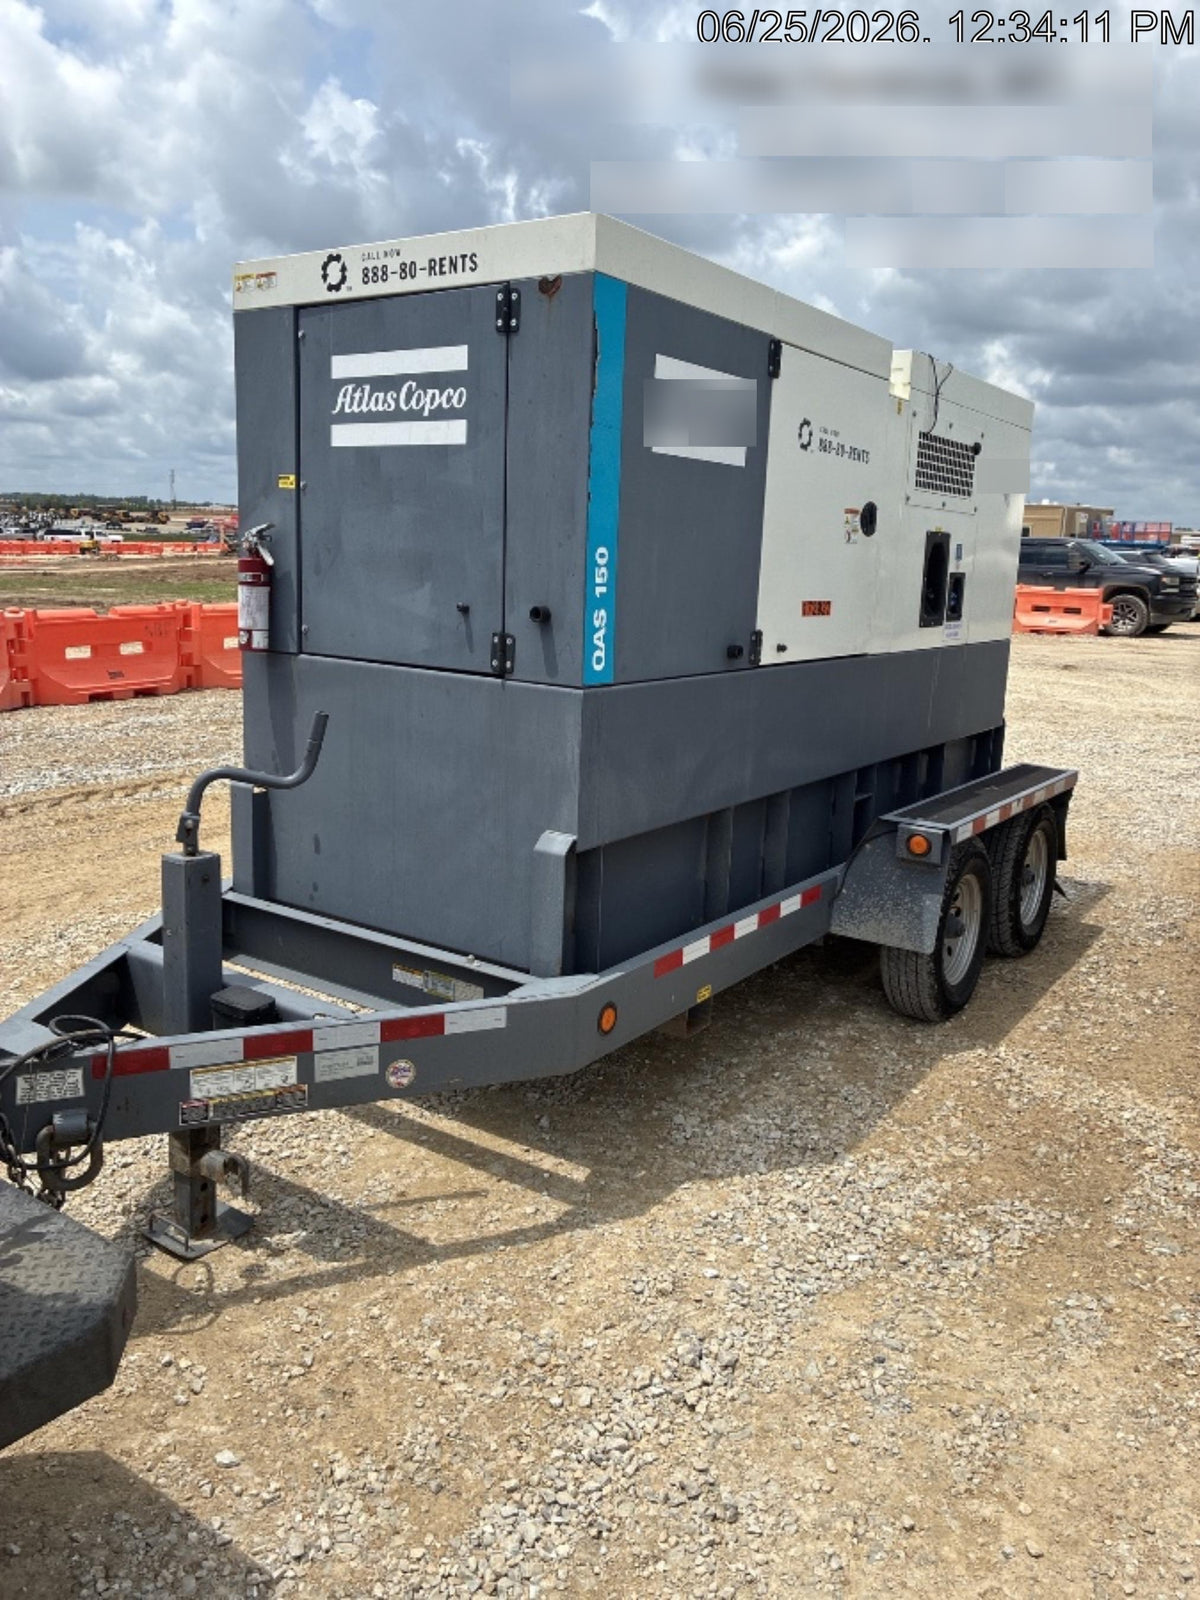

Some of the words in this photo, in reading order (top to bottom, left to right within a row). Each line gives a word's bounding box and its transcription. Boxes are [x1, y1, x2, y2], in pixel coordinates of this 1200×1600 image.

[361, 252, 478, 285] 888-80-RENTS
[331, 383, 397, 414] Atlas
[399, 380, 467, 416] Copco
[595, 547, 609, 598] 150
[592, 608, 607, 671] QAS
